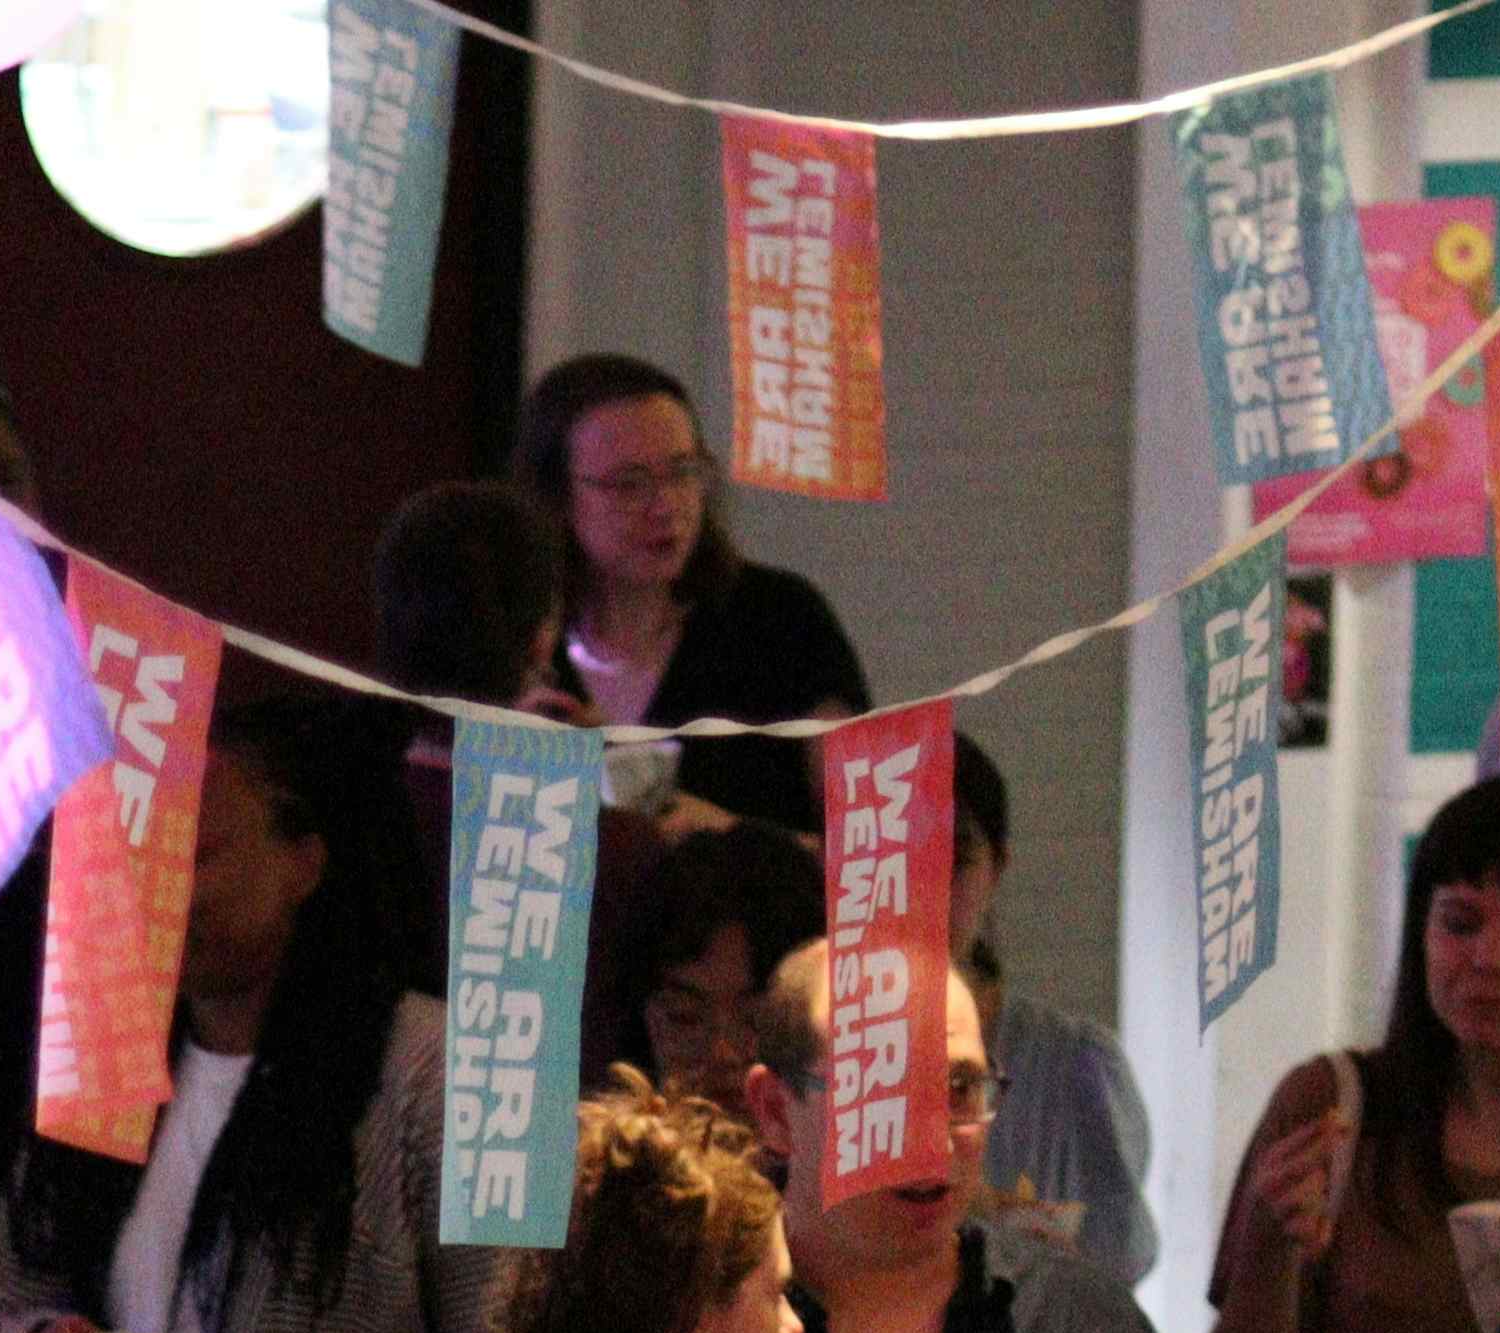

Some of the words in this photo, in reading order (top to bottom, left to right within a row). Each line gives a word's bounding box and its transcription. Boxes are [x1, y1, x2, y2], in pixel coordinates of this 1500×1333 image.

[1235, 580, 1272, 759] WE
[510, 775, 579, 961] WE
[867, 743, 921, 922] WE
[1201, 608, 1242, 1003] LEWISHAM
[1228, 772, 1264, 982] ARE
[452, 773, 534, 1182] LEWISHA
[833, 757, 878, 1178] LEWISHAM
[862, 948, 911, 1168] ARE
[471, 990, 543, 1221] ARE
